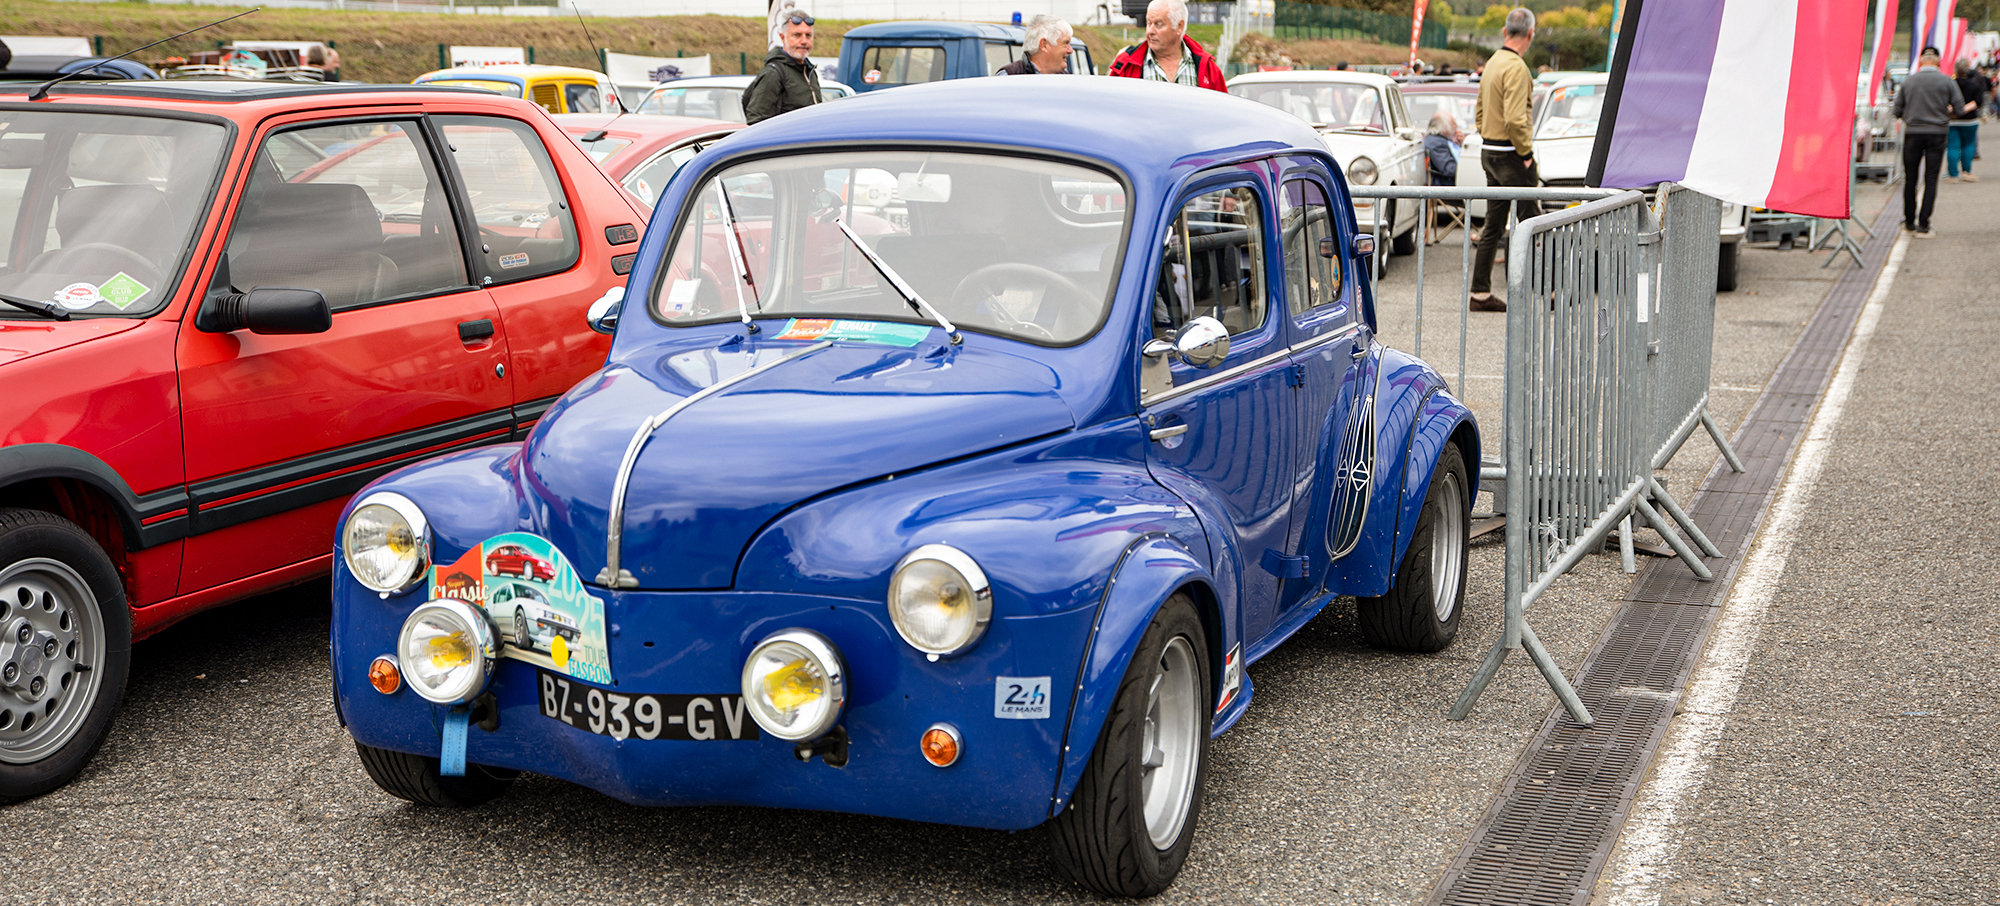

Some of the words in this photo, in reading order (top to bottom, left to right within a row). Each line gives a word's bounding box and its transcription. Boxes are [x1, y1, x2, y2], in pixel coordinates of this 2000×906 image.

[836, 320, 878, 332] RENAULT
[430, 579, 490, 603] Classic
[583, 644, 608, 667] TOUR
[568, 657, 611, 685] GASCON
[1004, 684, 1046, 705] 24h
[541, 673, 747, 741] BZ-939-GV
